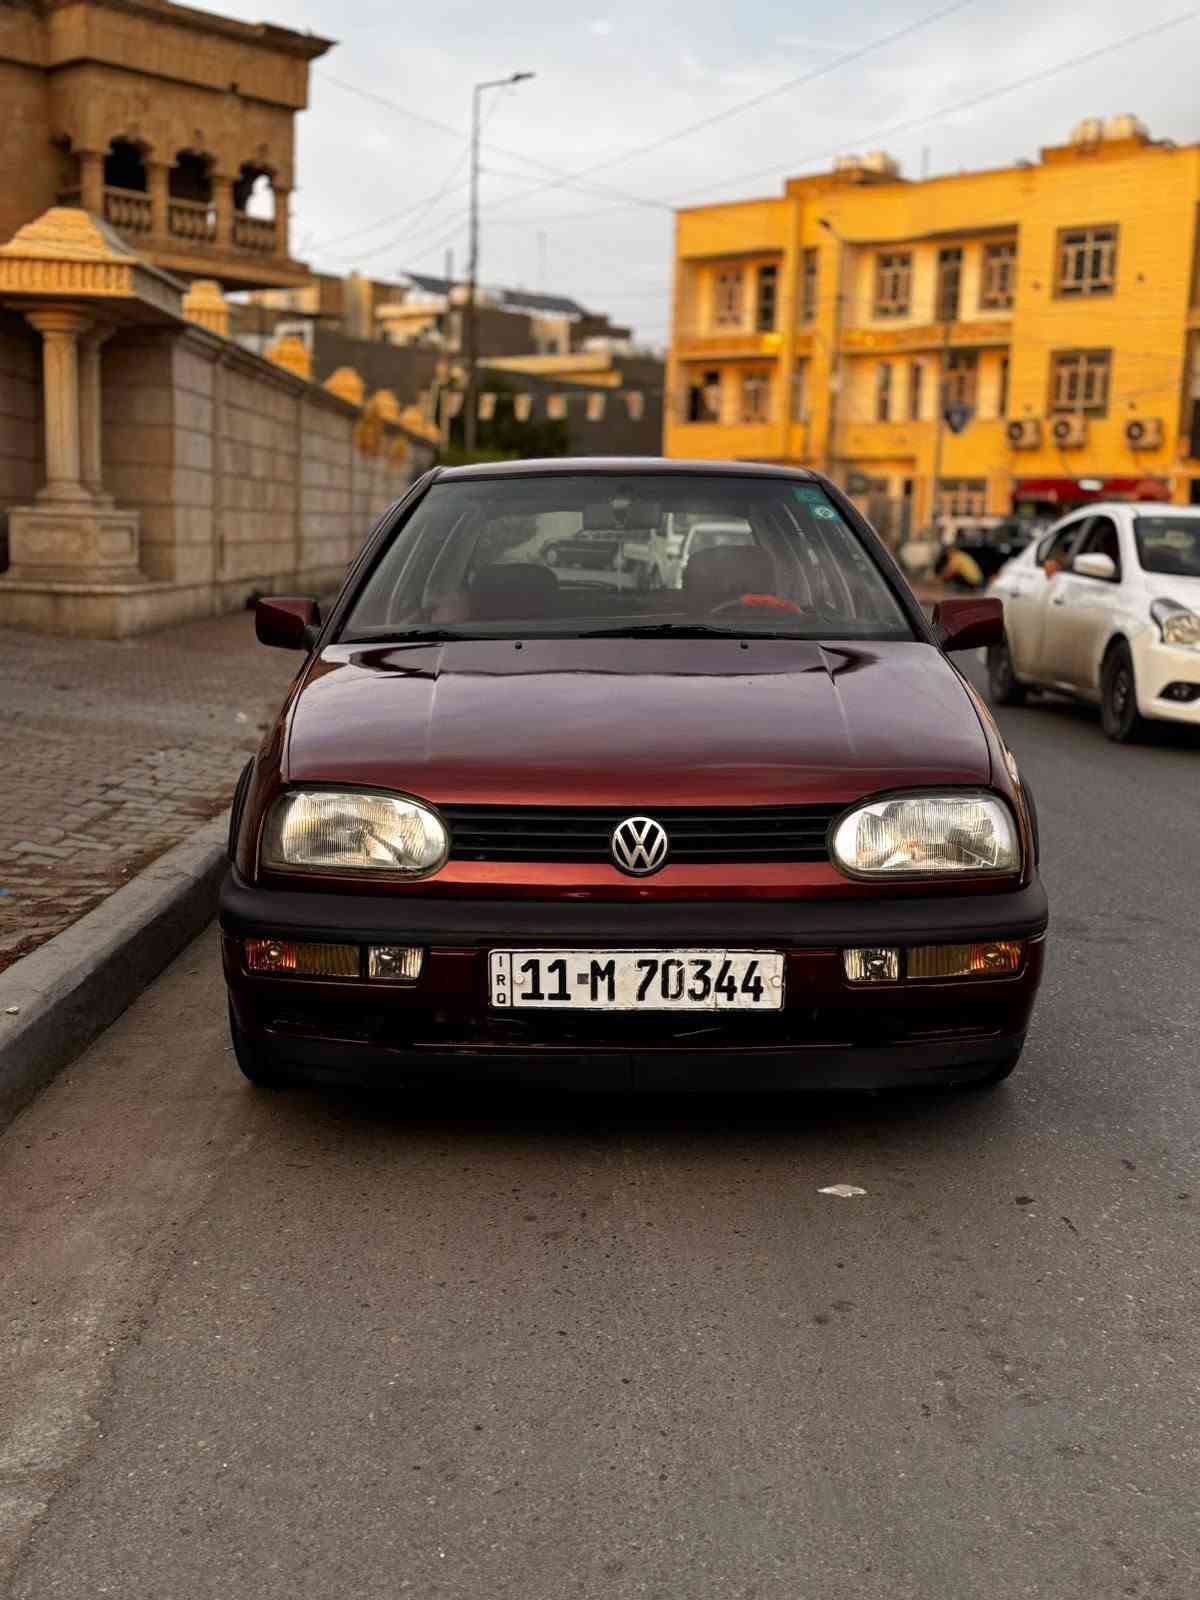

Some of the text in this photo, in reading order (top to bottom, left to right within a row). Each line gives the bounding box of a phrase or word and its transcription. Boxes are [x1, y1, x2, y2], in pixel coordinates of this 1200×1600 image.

[613, 817, 667, 872] VW
[521, 959, 764, 1002] 11 M 70344
